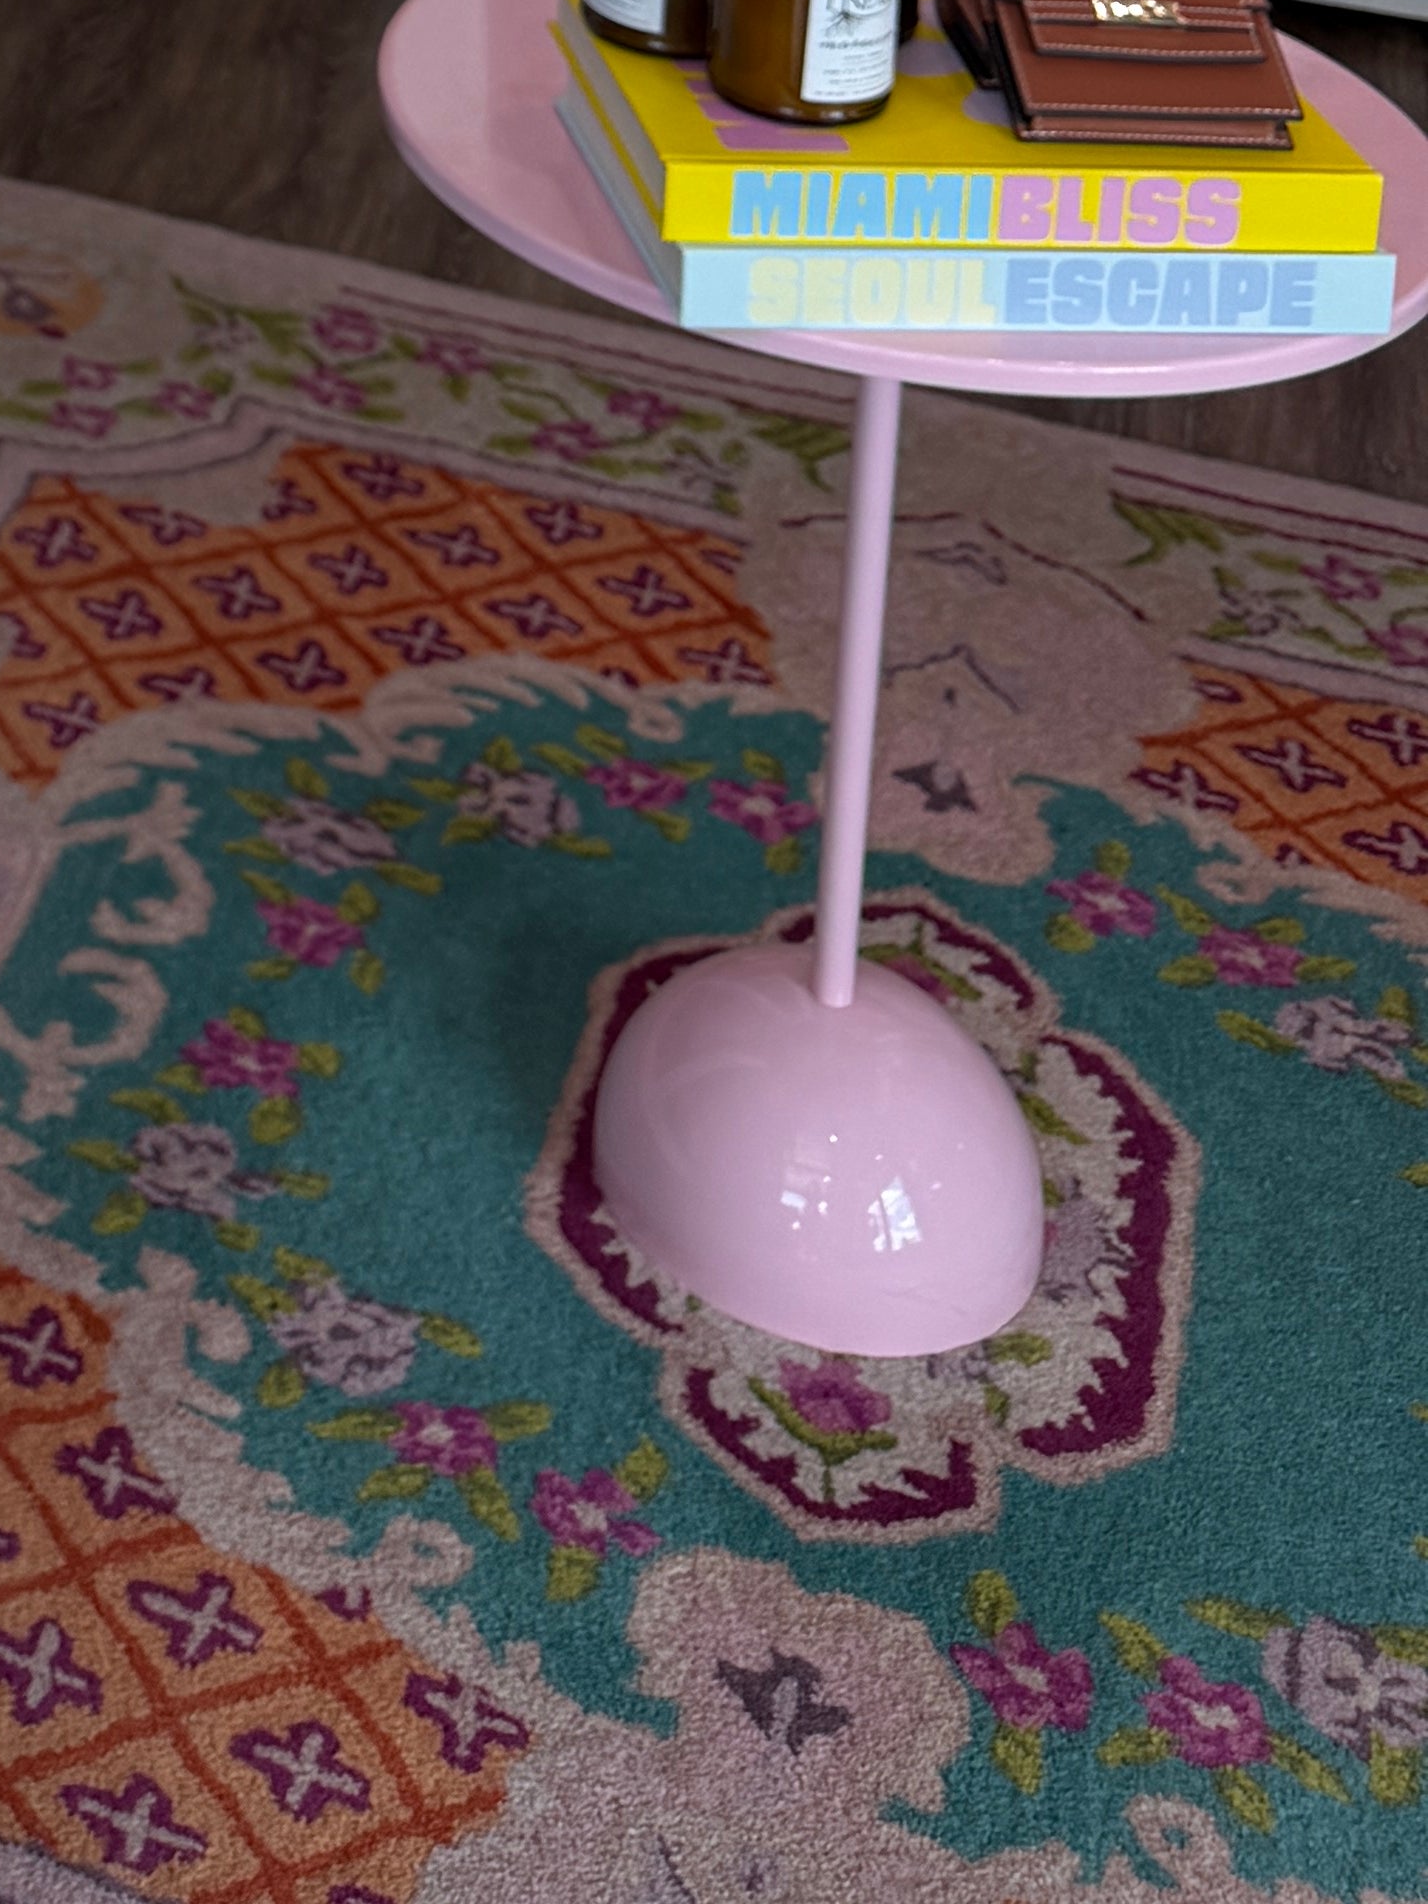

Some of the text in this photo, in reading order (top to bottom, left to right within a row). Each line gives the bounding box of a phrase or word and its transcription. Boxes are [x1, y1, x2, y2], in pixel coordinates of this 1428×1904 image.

[728, 170, 1241, 248] MIAMI BLISS
[748, 256, 1318, 328] SEOUL ESCAPE
